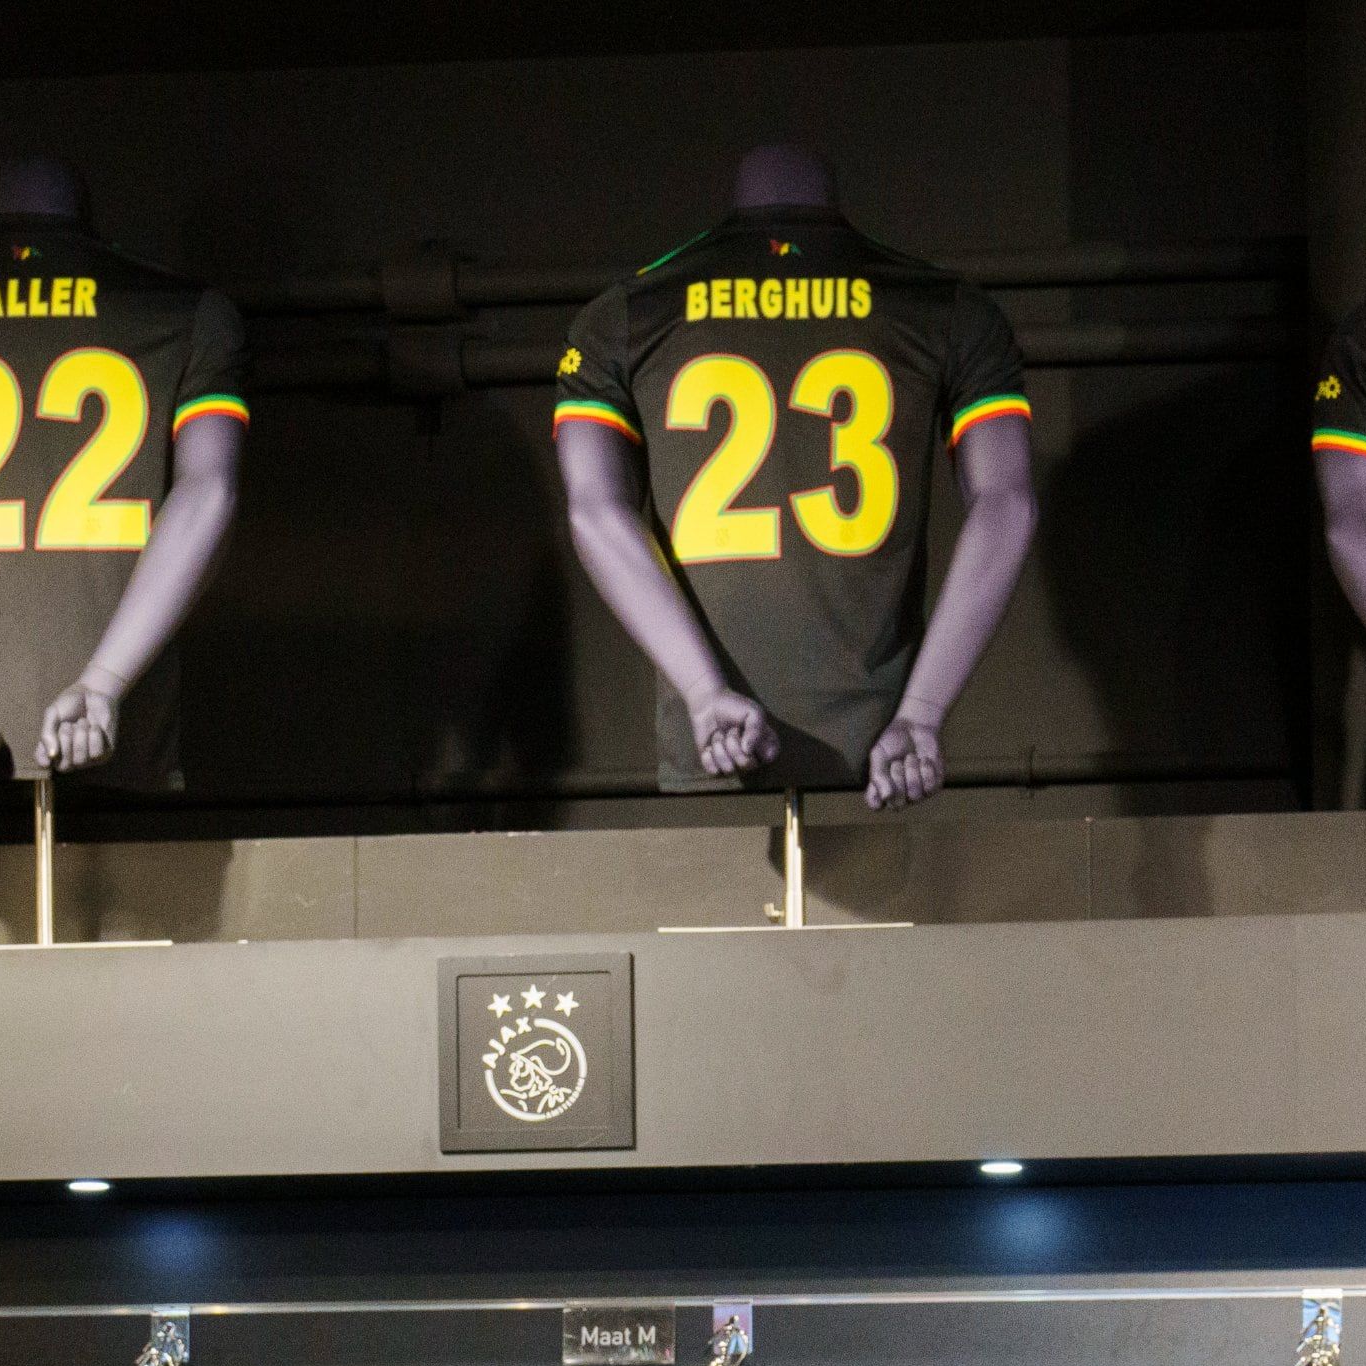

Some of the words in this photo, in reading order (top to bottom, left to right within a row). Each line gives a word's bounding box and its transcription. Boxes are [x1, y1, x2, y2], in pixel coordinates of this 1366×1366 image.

[686, 277, 873, 322] BERGHUIS
[665, 348, 900, 565] 23
[482, 1016, 533, 1069] AJAX
[580, 1325, 632, 1346] Maat
[638, 1325, 656, 1345] M
